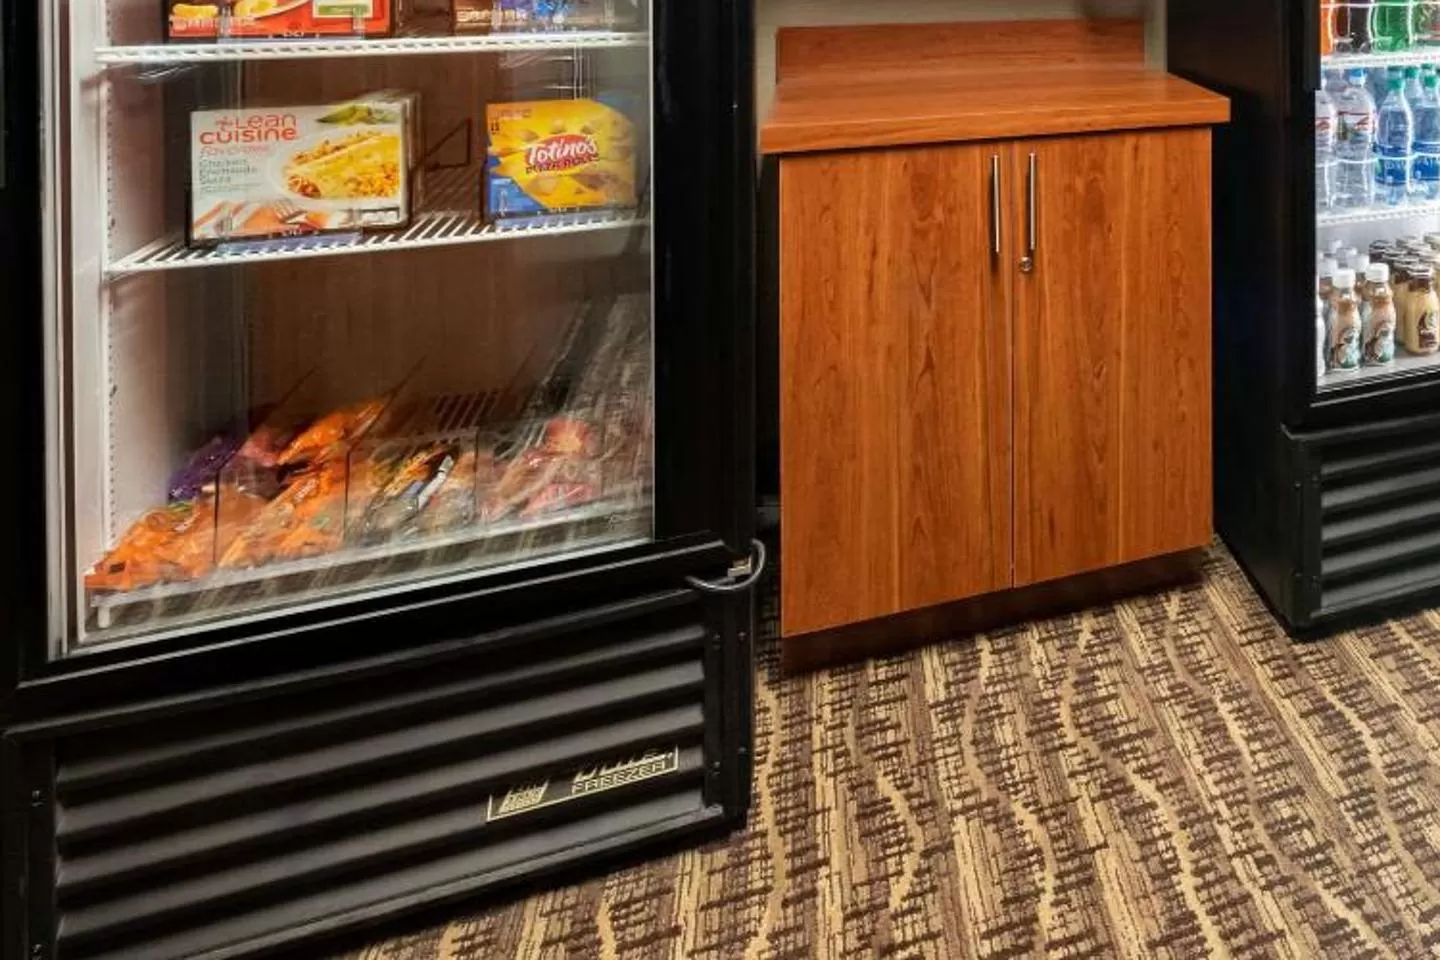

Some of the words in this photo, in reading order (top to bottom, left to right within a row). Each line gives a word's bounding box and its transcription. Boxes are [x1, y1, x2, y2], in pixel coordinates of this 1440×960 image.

[234, 113, 297, 130] Lean
[200, 128, 298, 145] cuisine
[528, 136, 598, 165] Totino's
